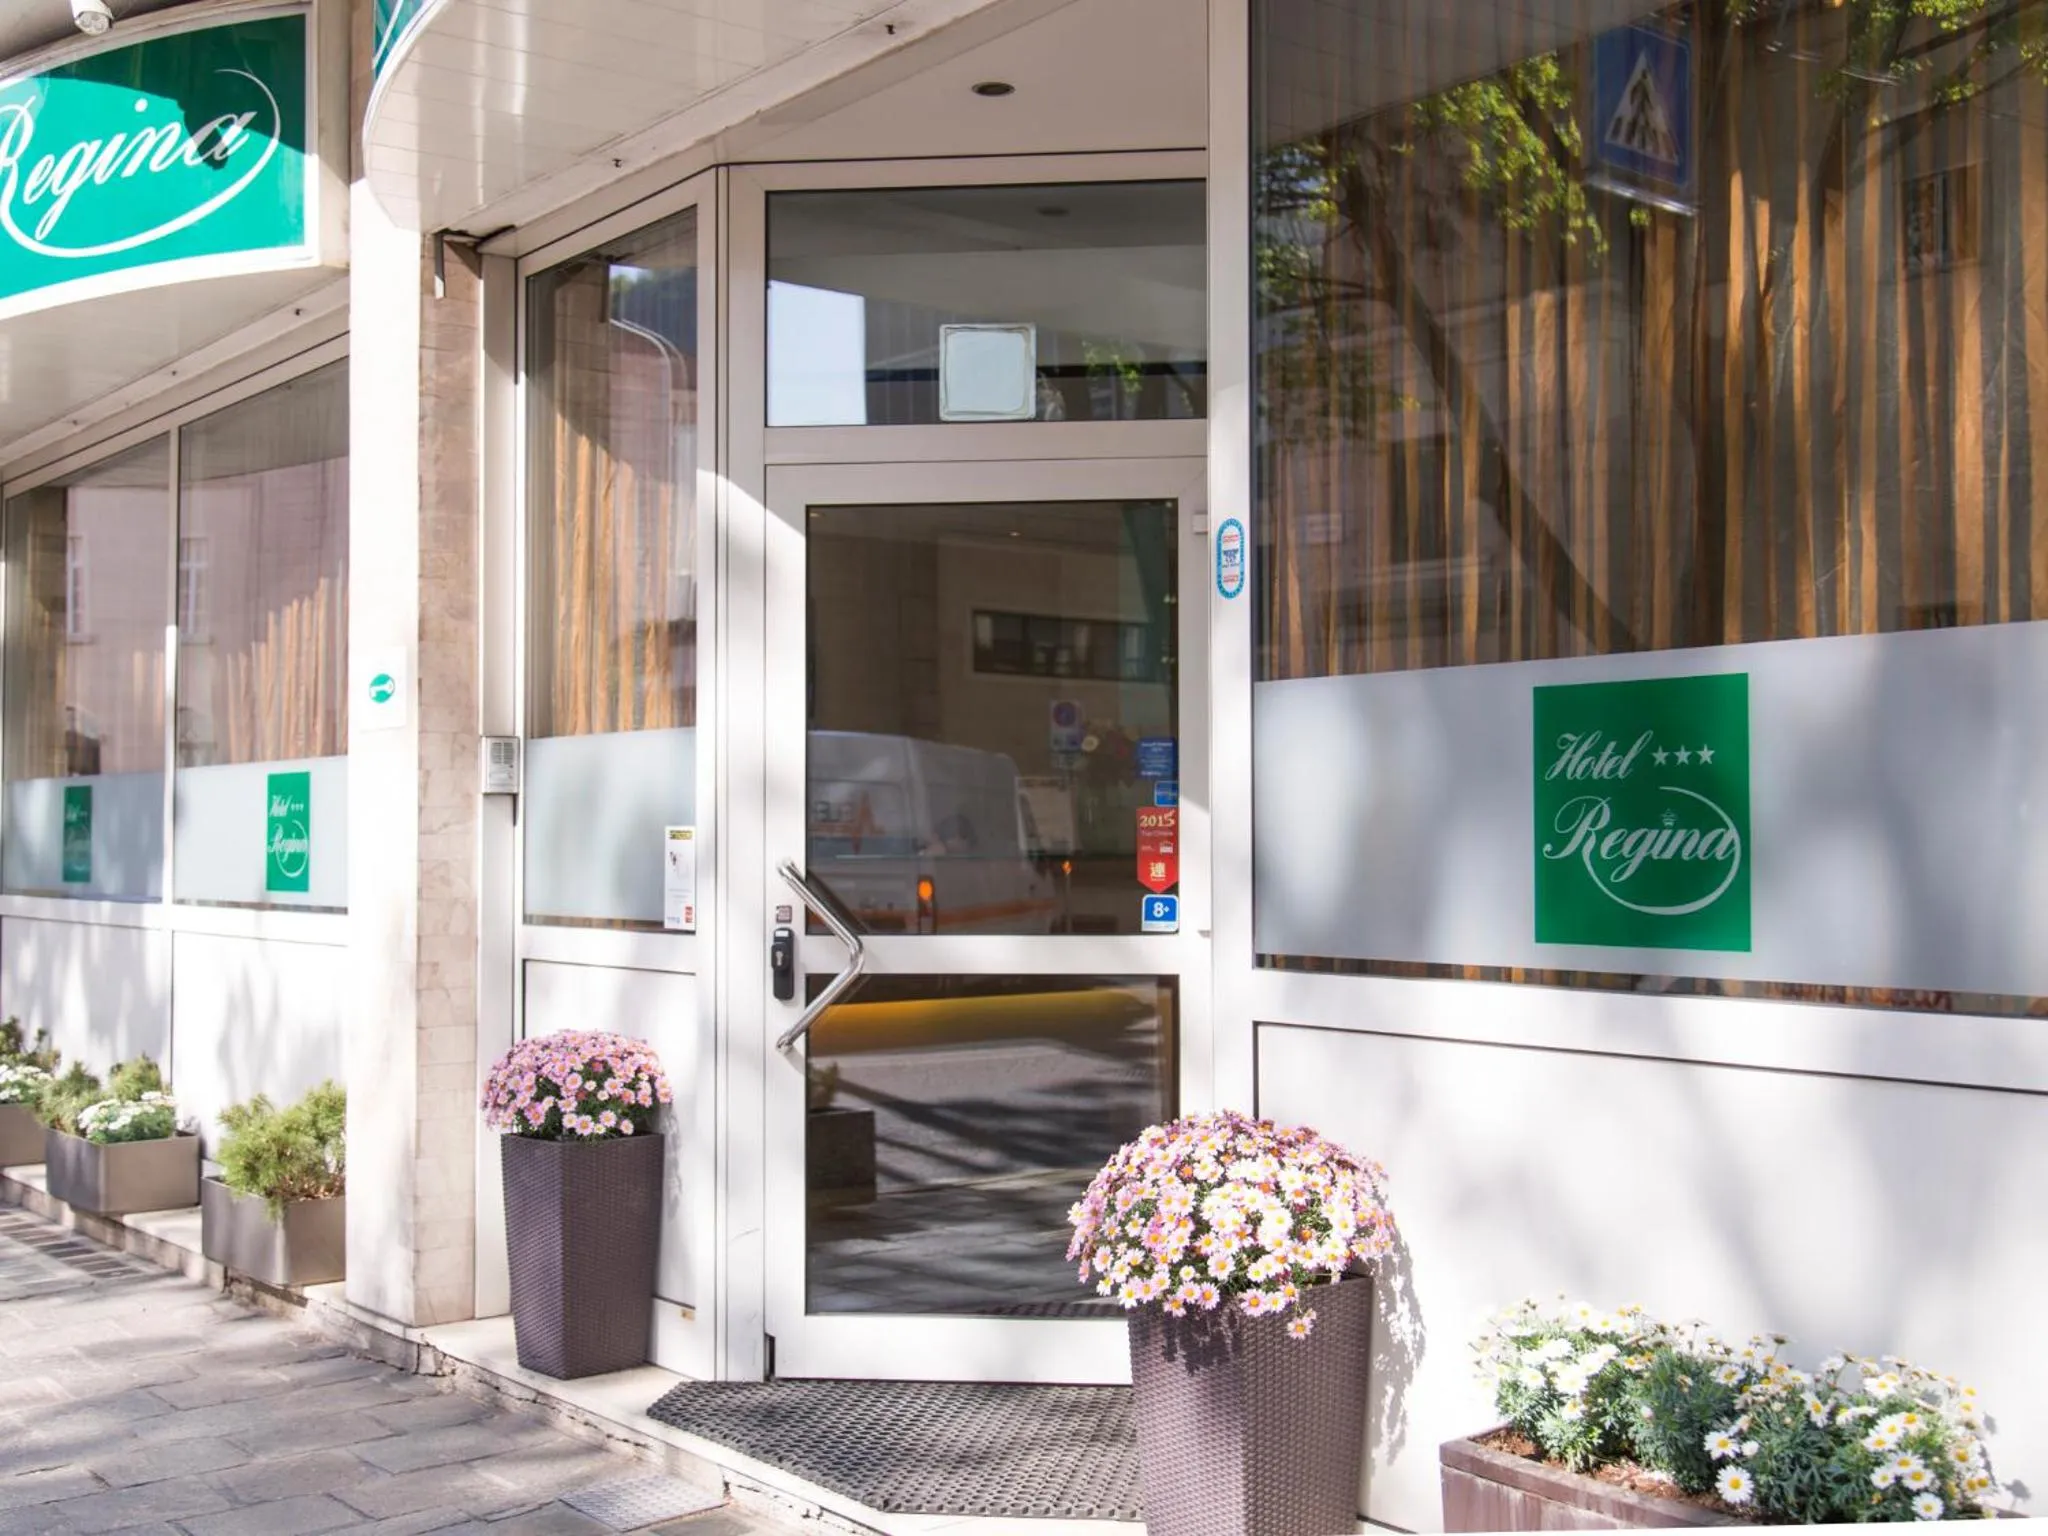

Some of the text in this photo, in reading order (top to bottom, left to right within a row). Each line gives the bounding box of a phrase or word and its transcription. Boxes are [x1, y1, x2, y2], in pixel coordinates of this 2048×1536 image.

[1545, 730, 1653, 780] Hotel
[1140, 811, 1176, 828] 2015
[1543, 795, 1740, 883] Regina
